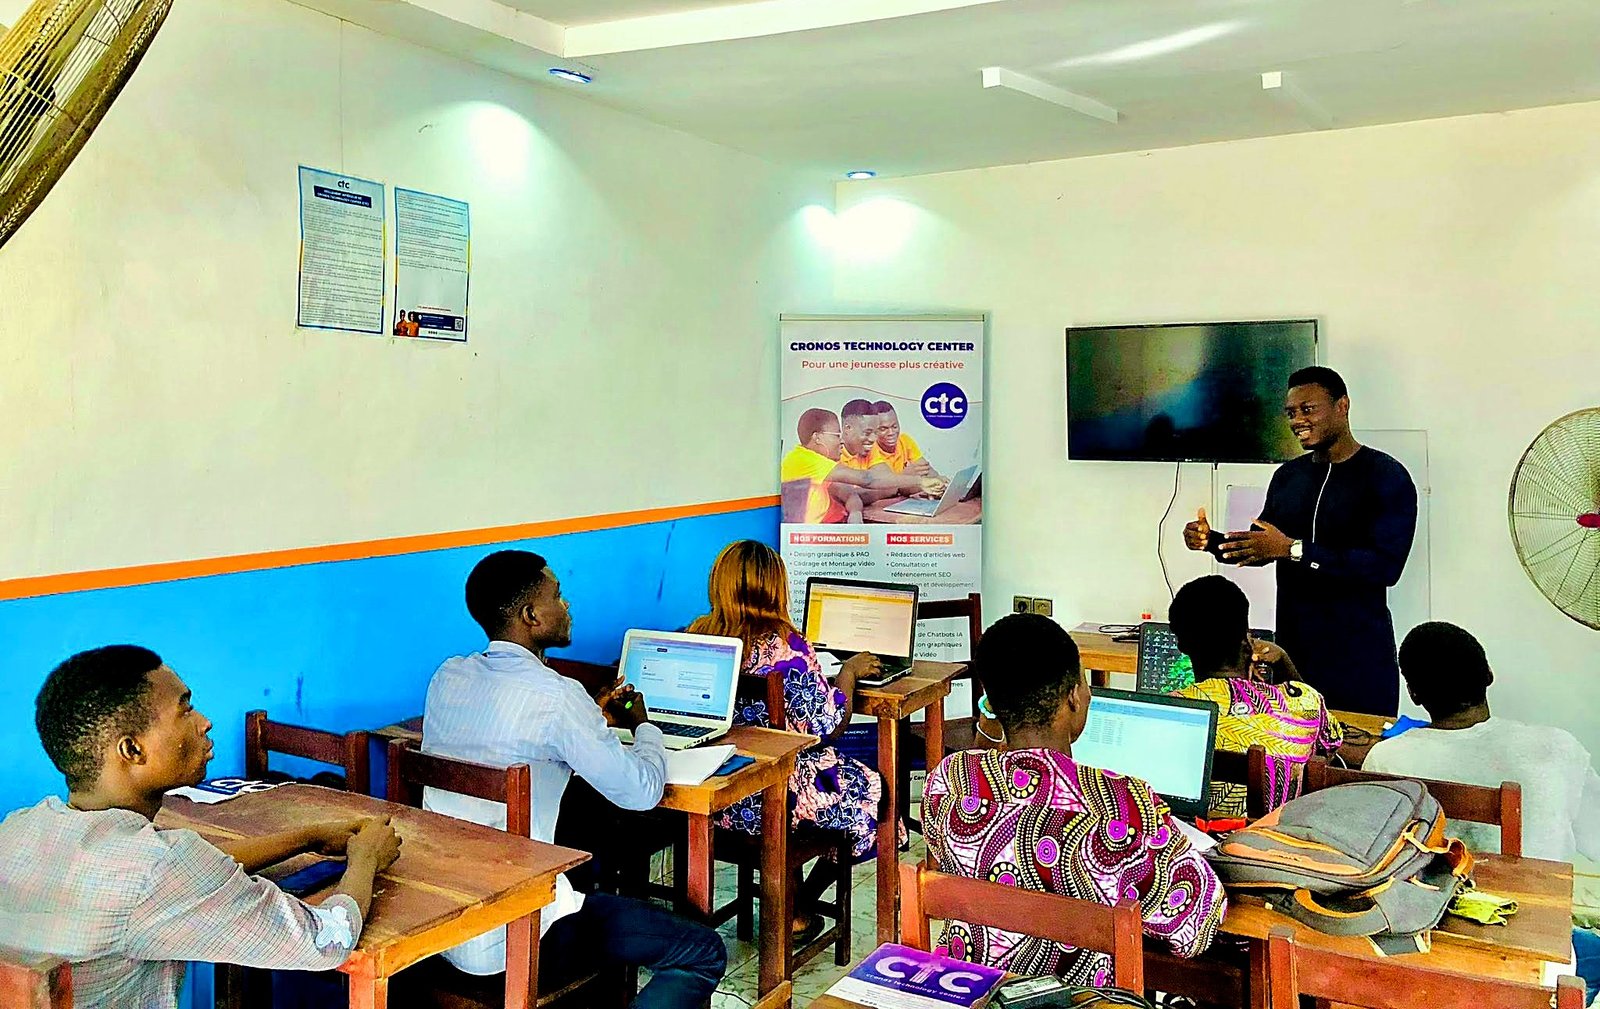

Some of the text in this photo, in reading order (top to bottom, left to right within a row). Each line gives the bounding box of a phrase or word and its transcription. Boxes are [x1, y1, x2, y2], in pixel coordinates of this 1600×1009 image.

[790, 342, 975, 351] CRONOS TECHNOLOGY CENTER
[802, 360, 964, 370] Pour une jeunesse plus créative
[793, 535, 866, 543] NOS FORMATIONS
[890, 535, 951, 543] NOS SERVICES
